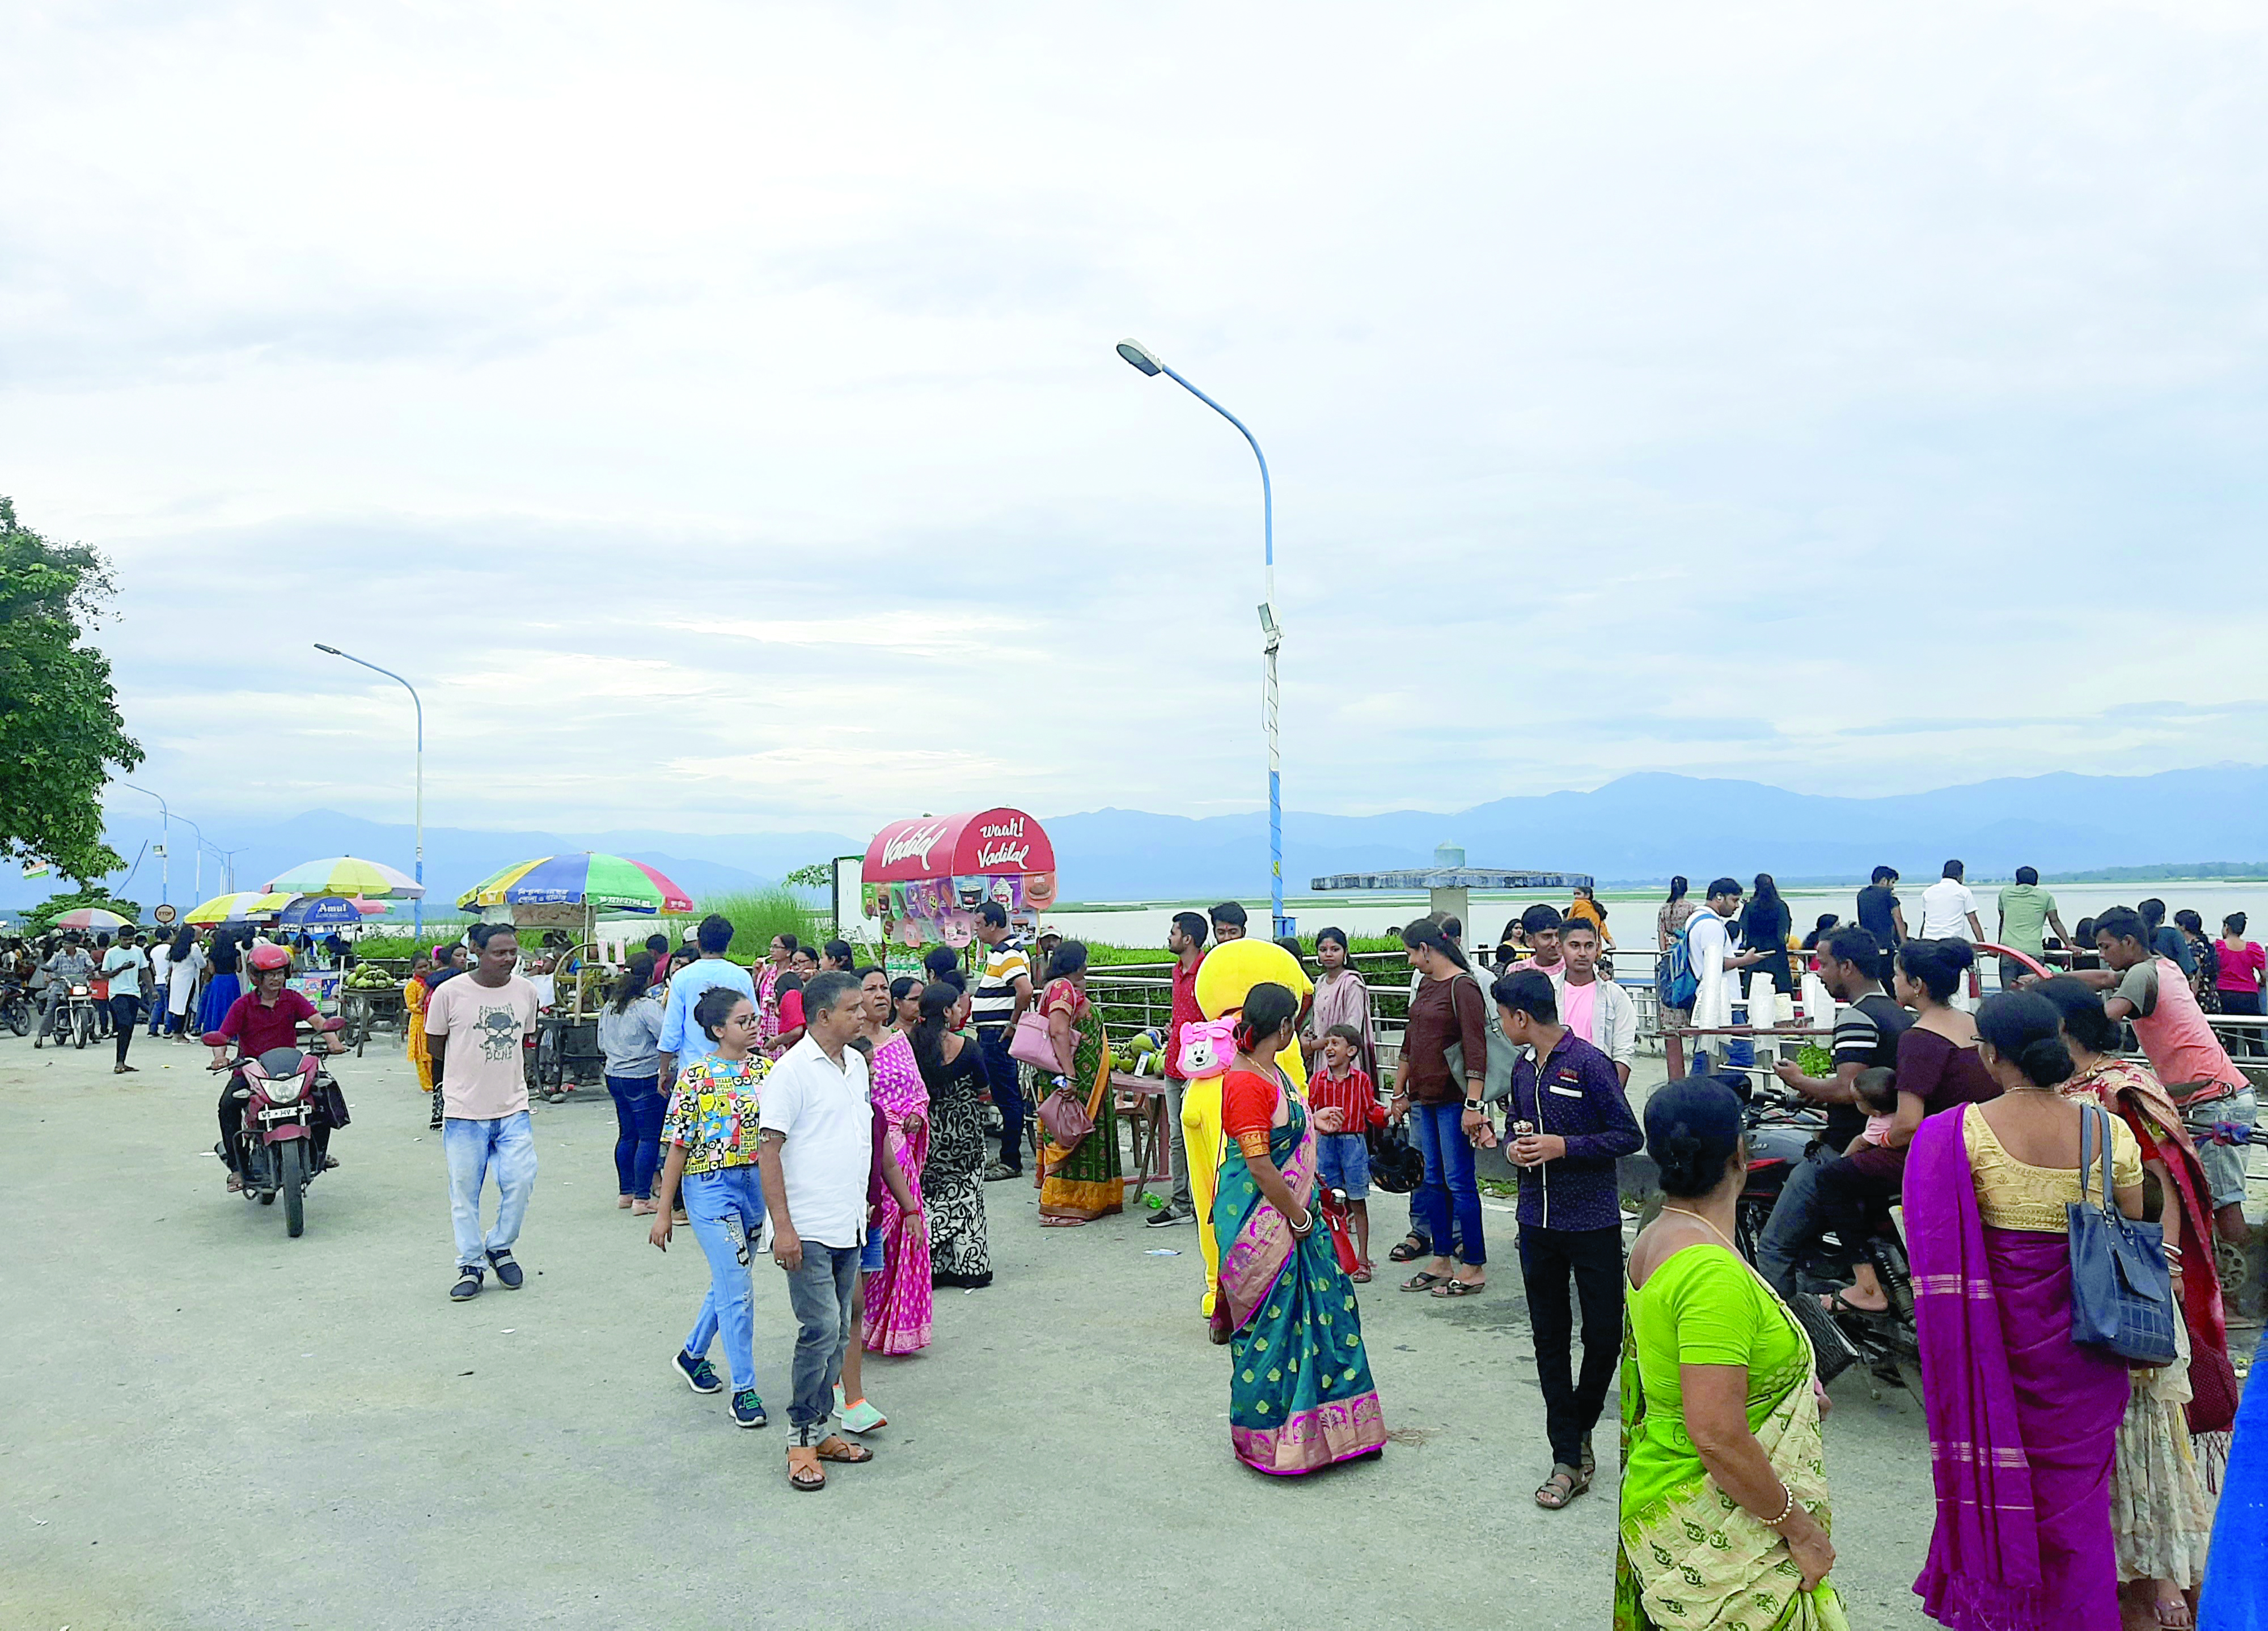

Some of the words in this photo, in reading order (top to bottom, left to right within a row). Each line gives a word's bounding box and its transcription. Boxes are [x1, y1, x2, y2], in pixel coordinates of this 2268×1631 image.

[979, 816, 1025, 838] waah!
[881, 823, 947, 871] Vadilal
[977, 841, 1030, 870] Vadilal
[318, 903, 346, 913] Amul
